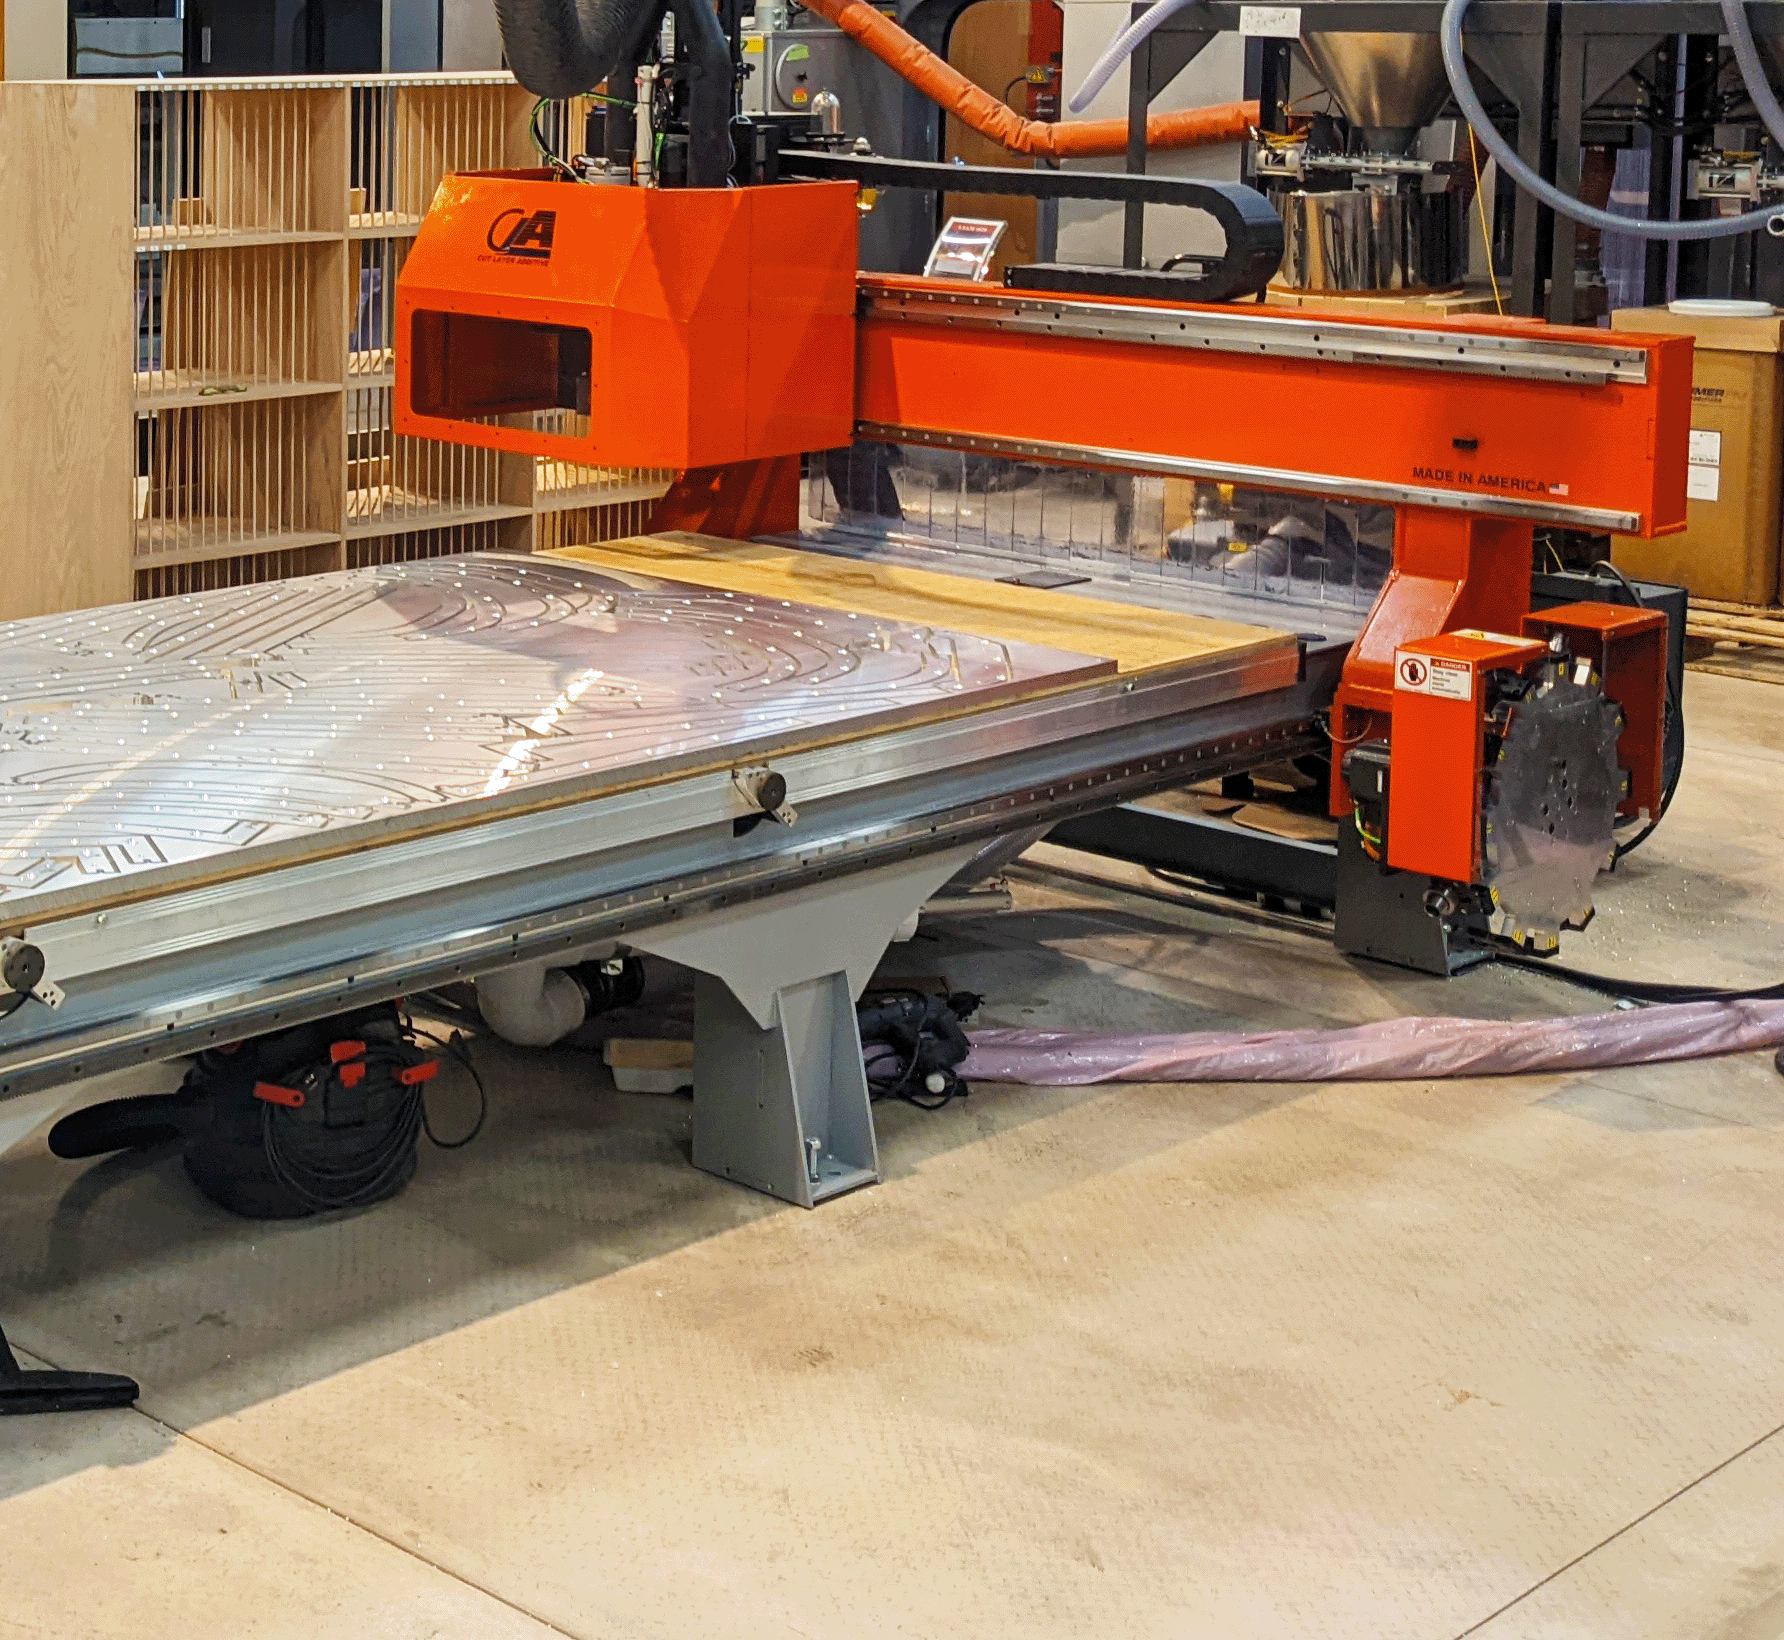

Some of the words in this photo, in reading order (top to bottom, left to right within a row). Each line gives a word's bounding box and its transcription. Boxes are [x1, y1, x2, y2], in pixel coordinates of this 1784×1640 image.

[1413, 466, 1454, 482] MADE
[1459, 471, 1473, 484] IN
[1478, 474, 1546, 493] AMERICA
